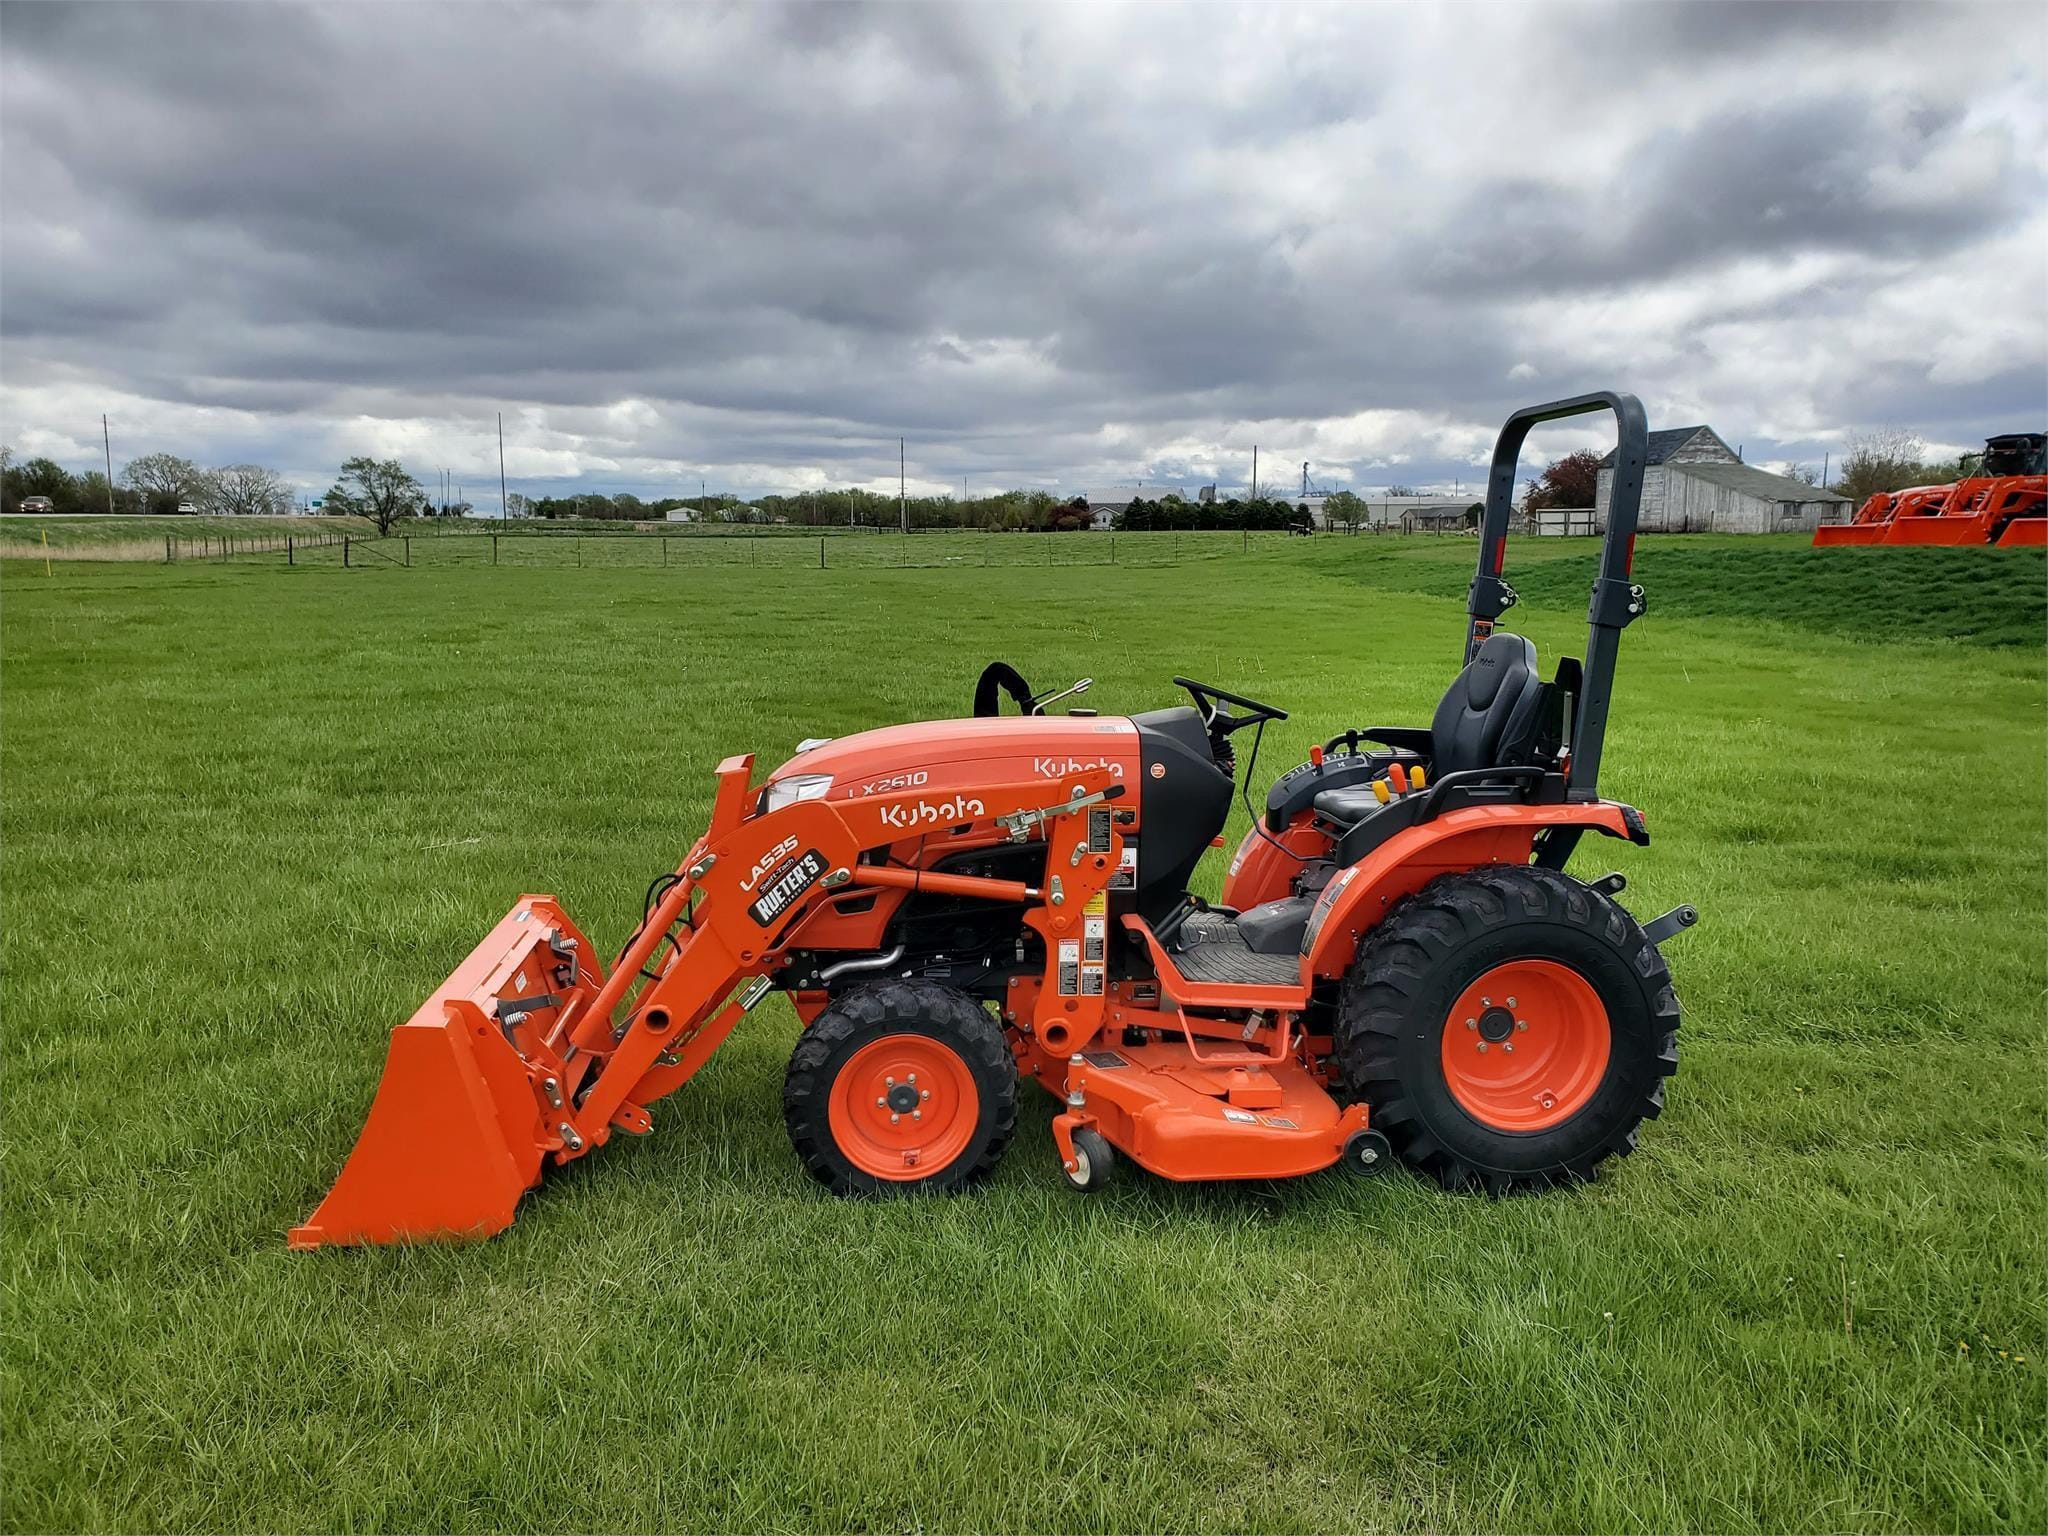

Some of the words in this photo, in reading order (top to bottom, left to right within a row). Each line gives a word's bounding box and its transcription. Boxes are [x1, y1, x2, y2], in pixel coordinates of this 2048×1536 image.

[880, 795, 985, 828] Kubota
[739, 834, 799, 892] LA535
[755, 854, 820, 921] RUETER'S
